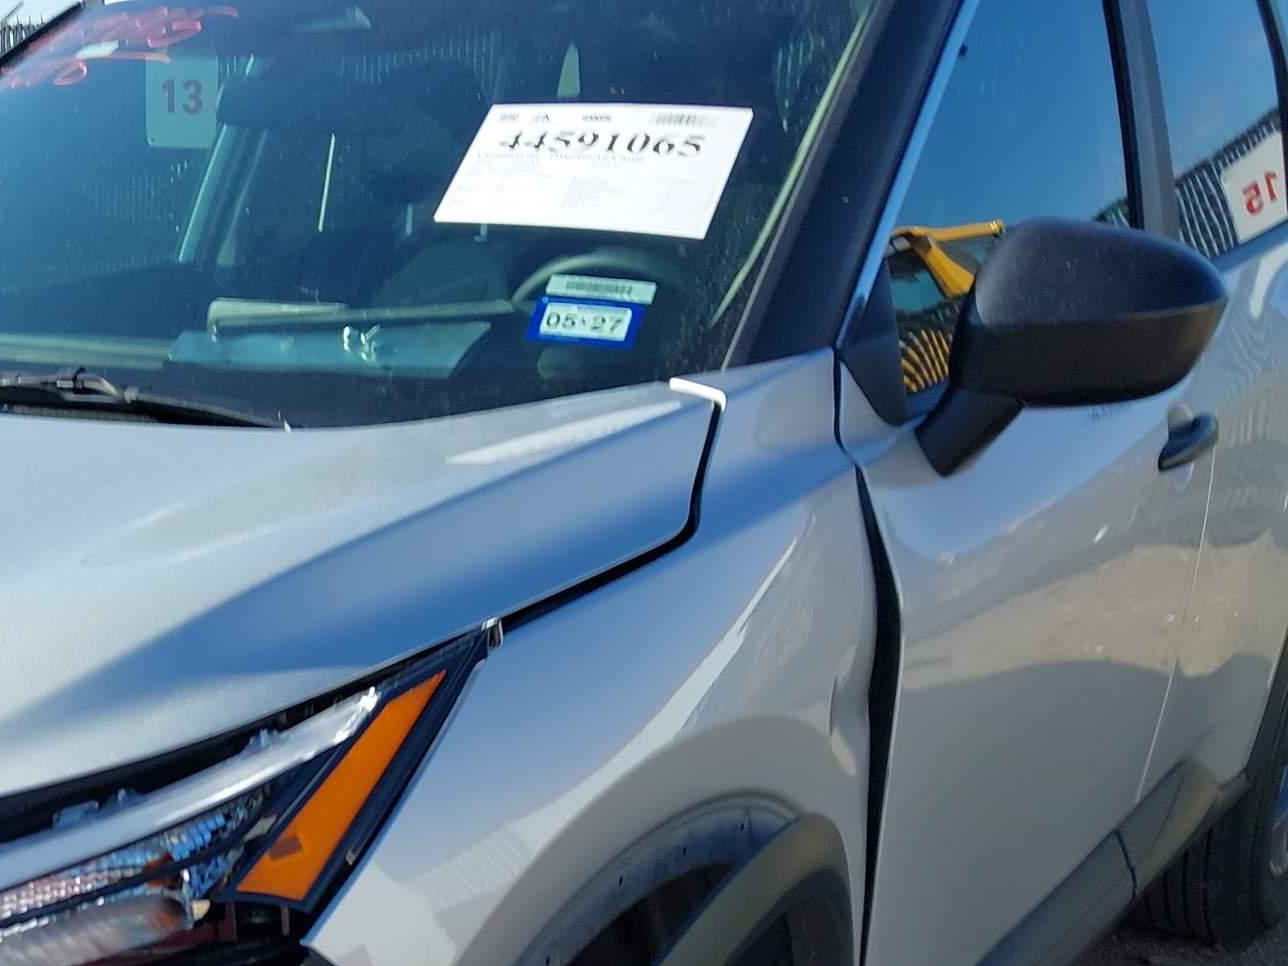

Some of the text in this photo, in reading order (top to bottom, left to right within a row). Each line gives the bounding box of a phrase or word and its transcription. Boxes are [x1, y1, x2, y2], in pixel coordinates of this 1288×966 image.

[162, 78, 203, 115] 13
[499, 130, 705, 158] 44591065
[546, 311, 624, 333] 05 27
